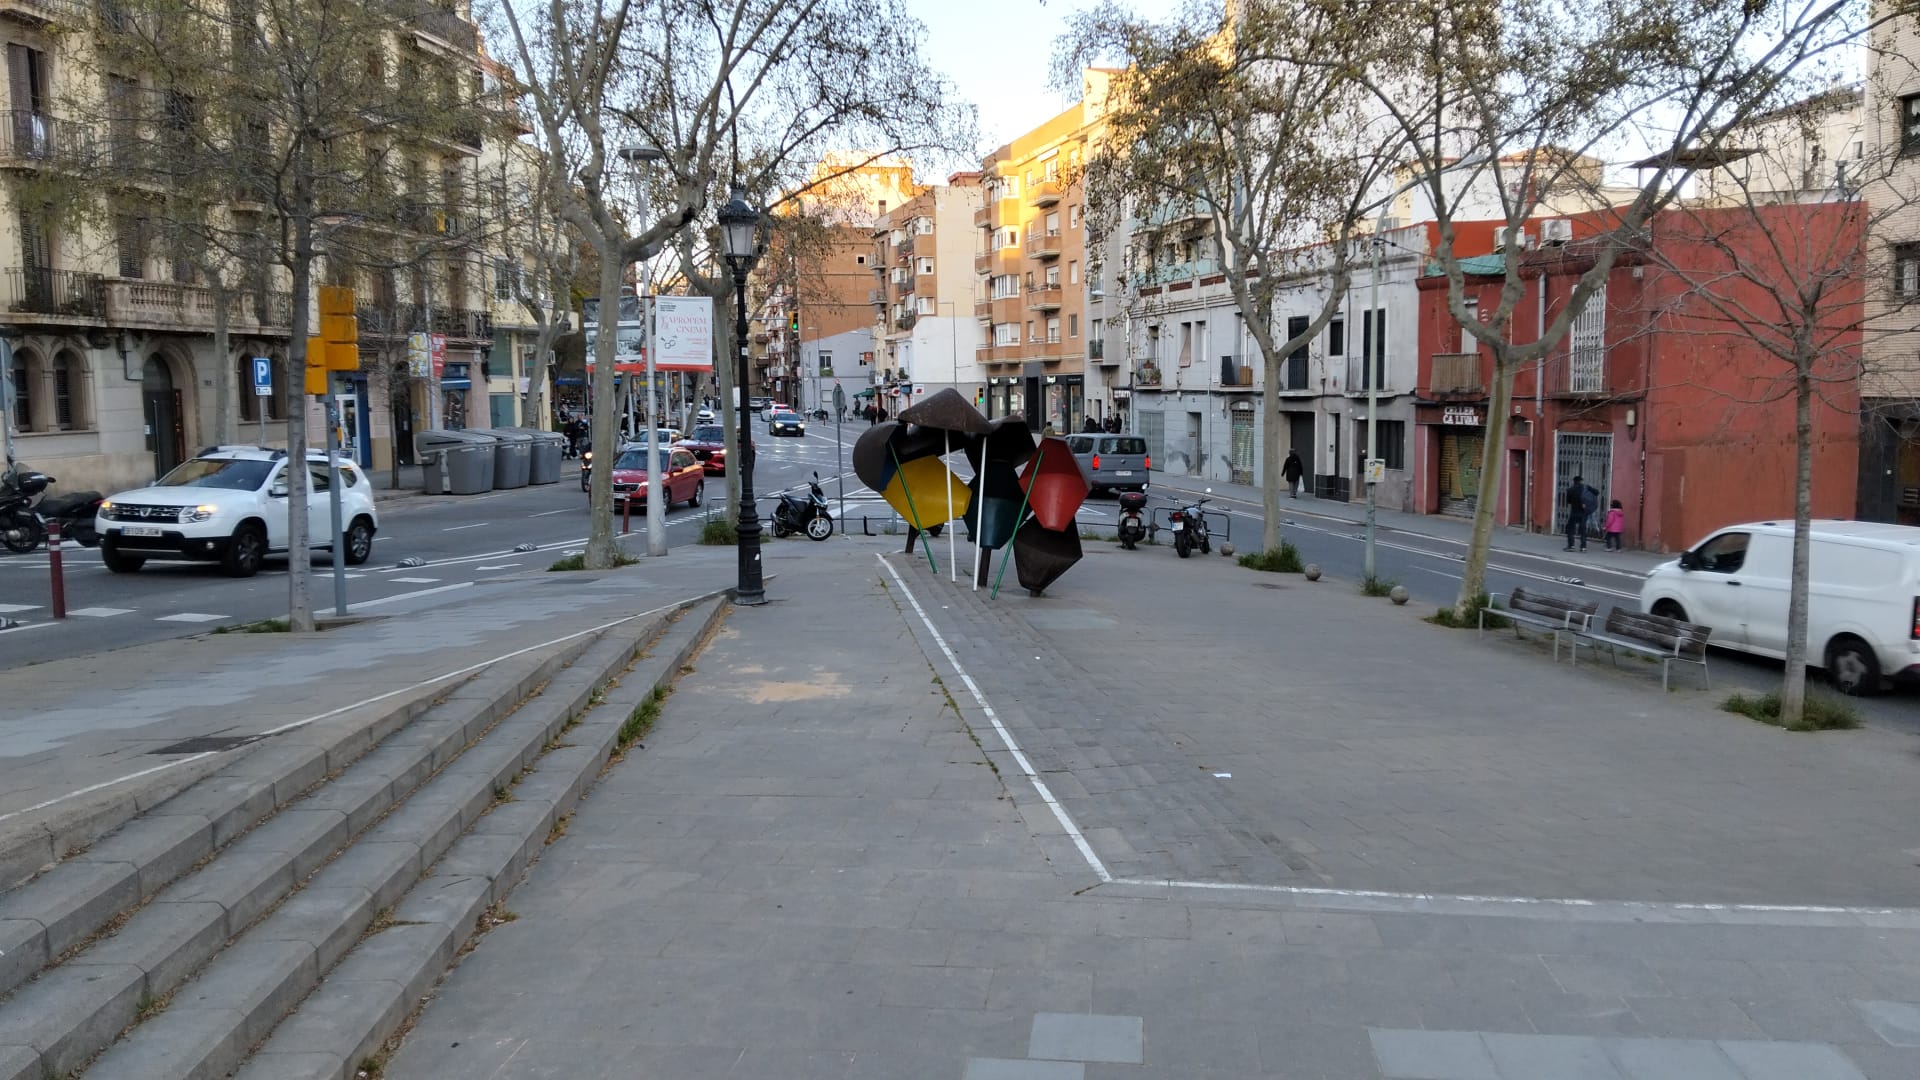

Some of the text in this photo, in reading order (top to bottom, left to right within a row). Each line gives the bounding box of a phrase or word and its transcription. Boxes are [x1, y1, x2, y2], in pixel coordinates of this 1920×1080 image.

[256, 361, 268, 383] P
[1444, 406, 1474, 415] CELLER
[1443, 415, 1454, 424] CA
